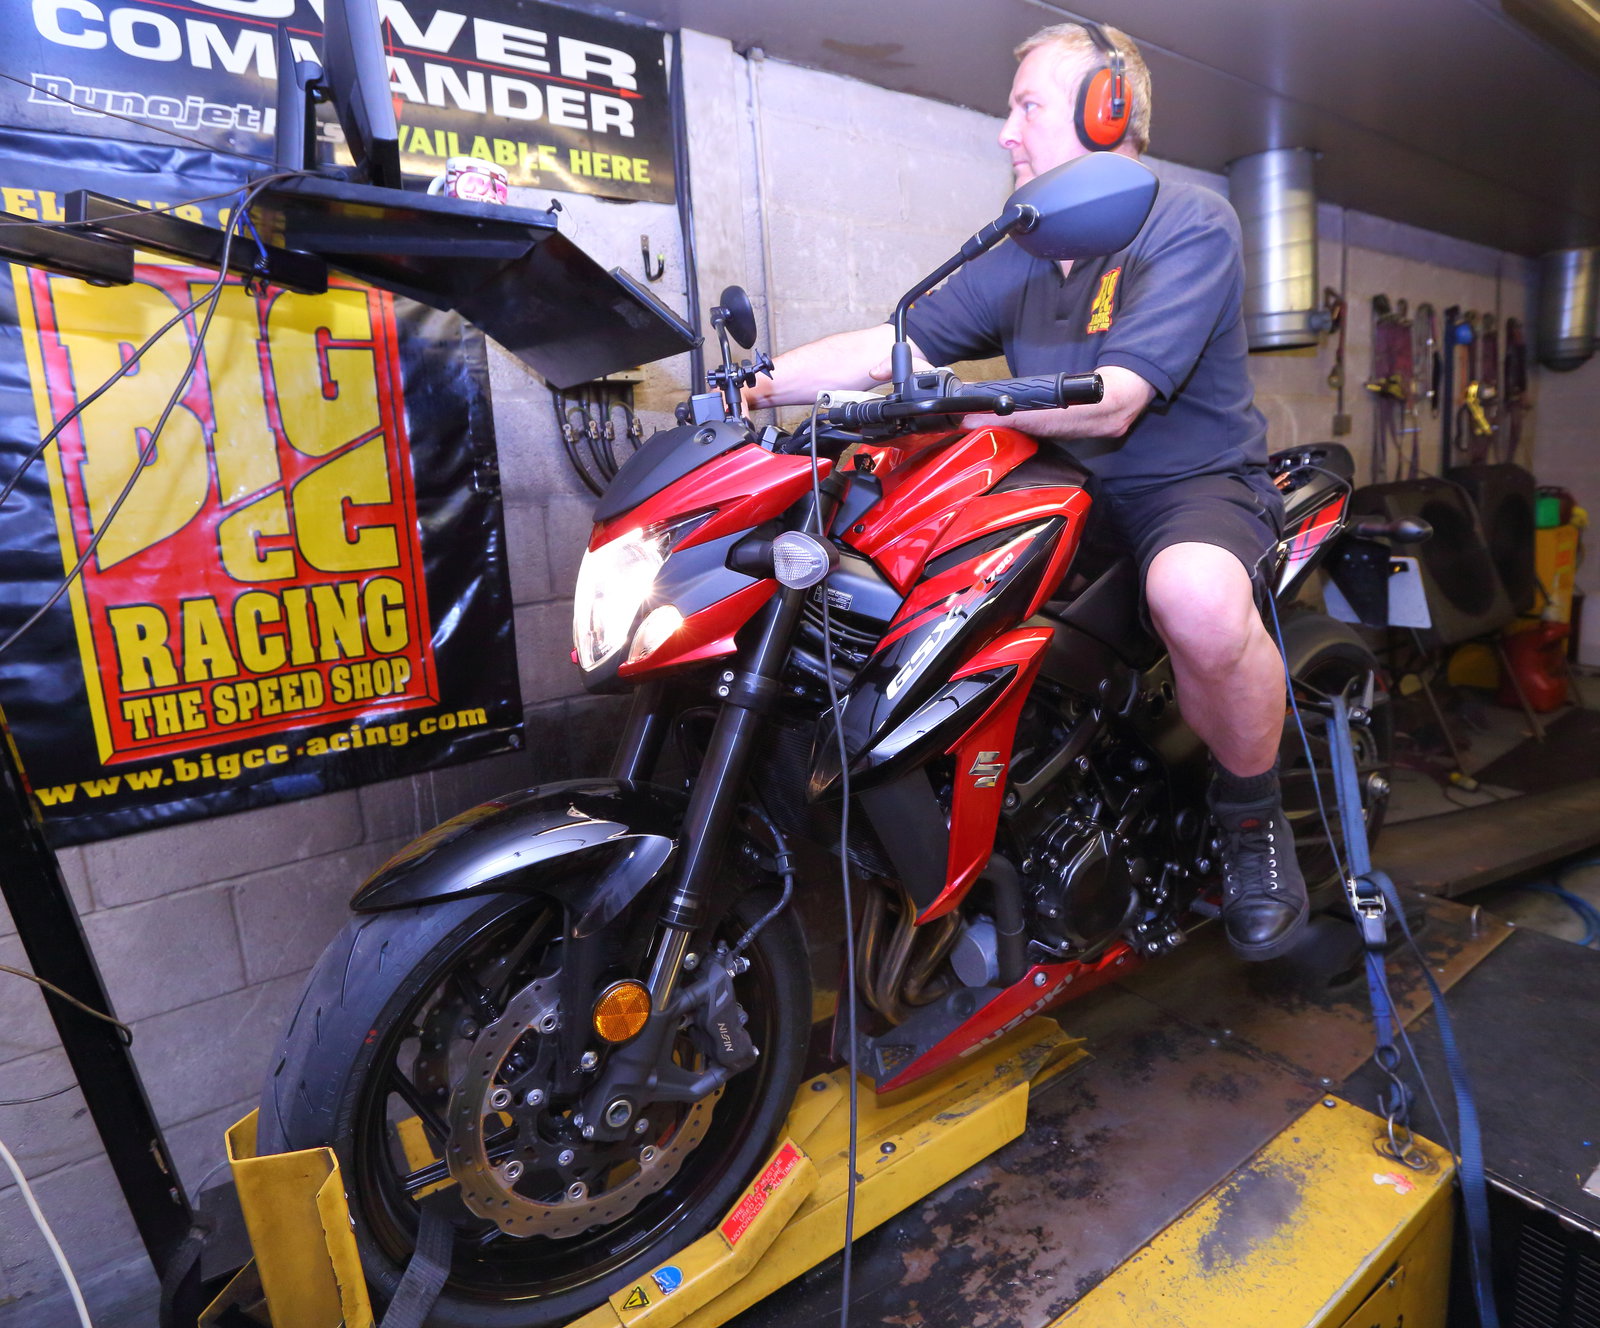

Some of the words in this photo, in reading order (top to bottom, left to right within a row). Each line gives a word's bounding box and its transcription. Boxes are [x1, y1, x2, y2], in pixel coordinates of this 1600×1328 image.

[28, 72, 261, 131] Dynojet
[569, 149, 651, 184] HERE
[48, 276, 386, 573] BIG
[105, 577, 410, 693] RACING
[123, 688, 206, 741] THE
[211, 666, 323, 726] SPEED
[330, 657, 411, 703] SHOP
[34, 705, 487, 807] www.bigccacing.com
[717, 1022, 735, 1053] NISSIN
[781, 1156, 799, 1177] TIMES
[732, 1207, 745, 1223] TIRE
[739, 1202, 755, 1223] USED
